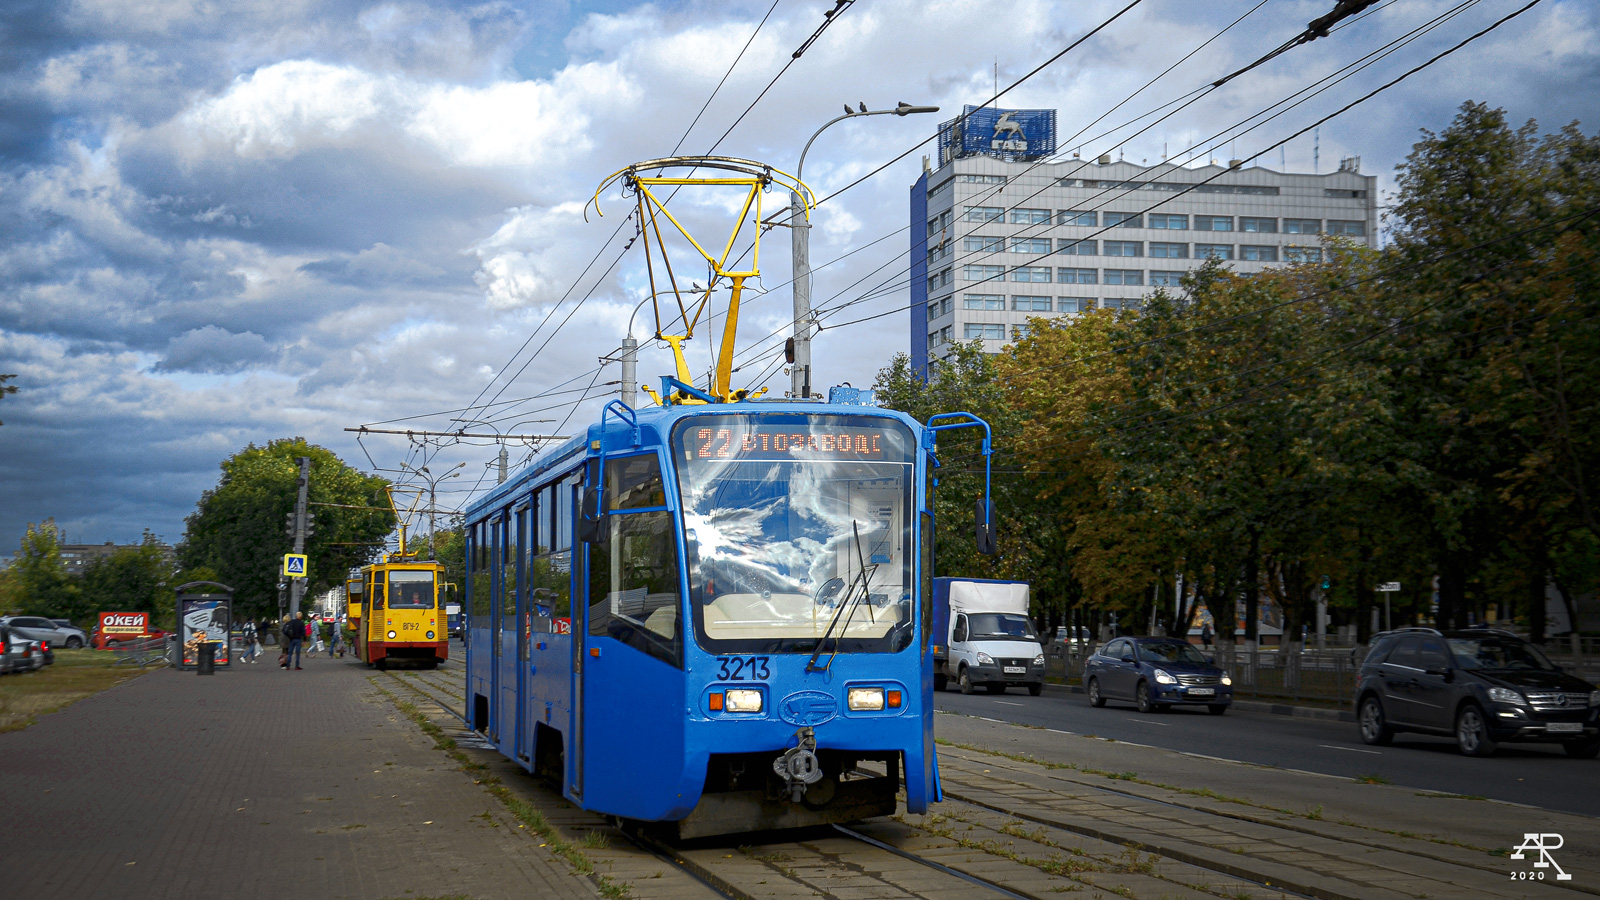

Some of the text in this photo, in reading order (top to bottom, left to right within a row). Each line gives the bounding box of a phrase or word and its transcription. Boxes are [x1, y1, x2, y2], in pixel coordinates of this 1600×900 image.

[991, 139, 1028, 151] ГАЗ
[698, 428, 732, 458] 22
[716, 657, 771, 681] 3213
